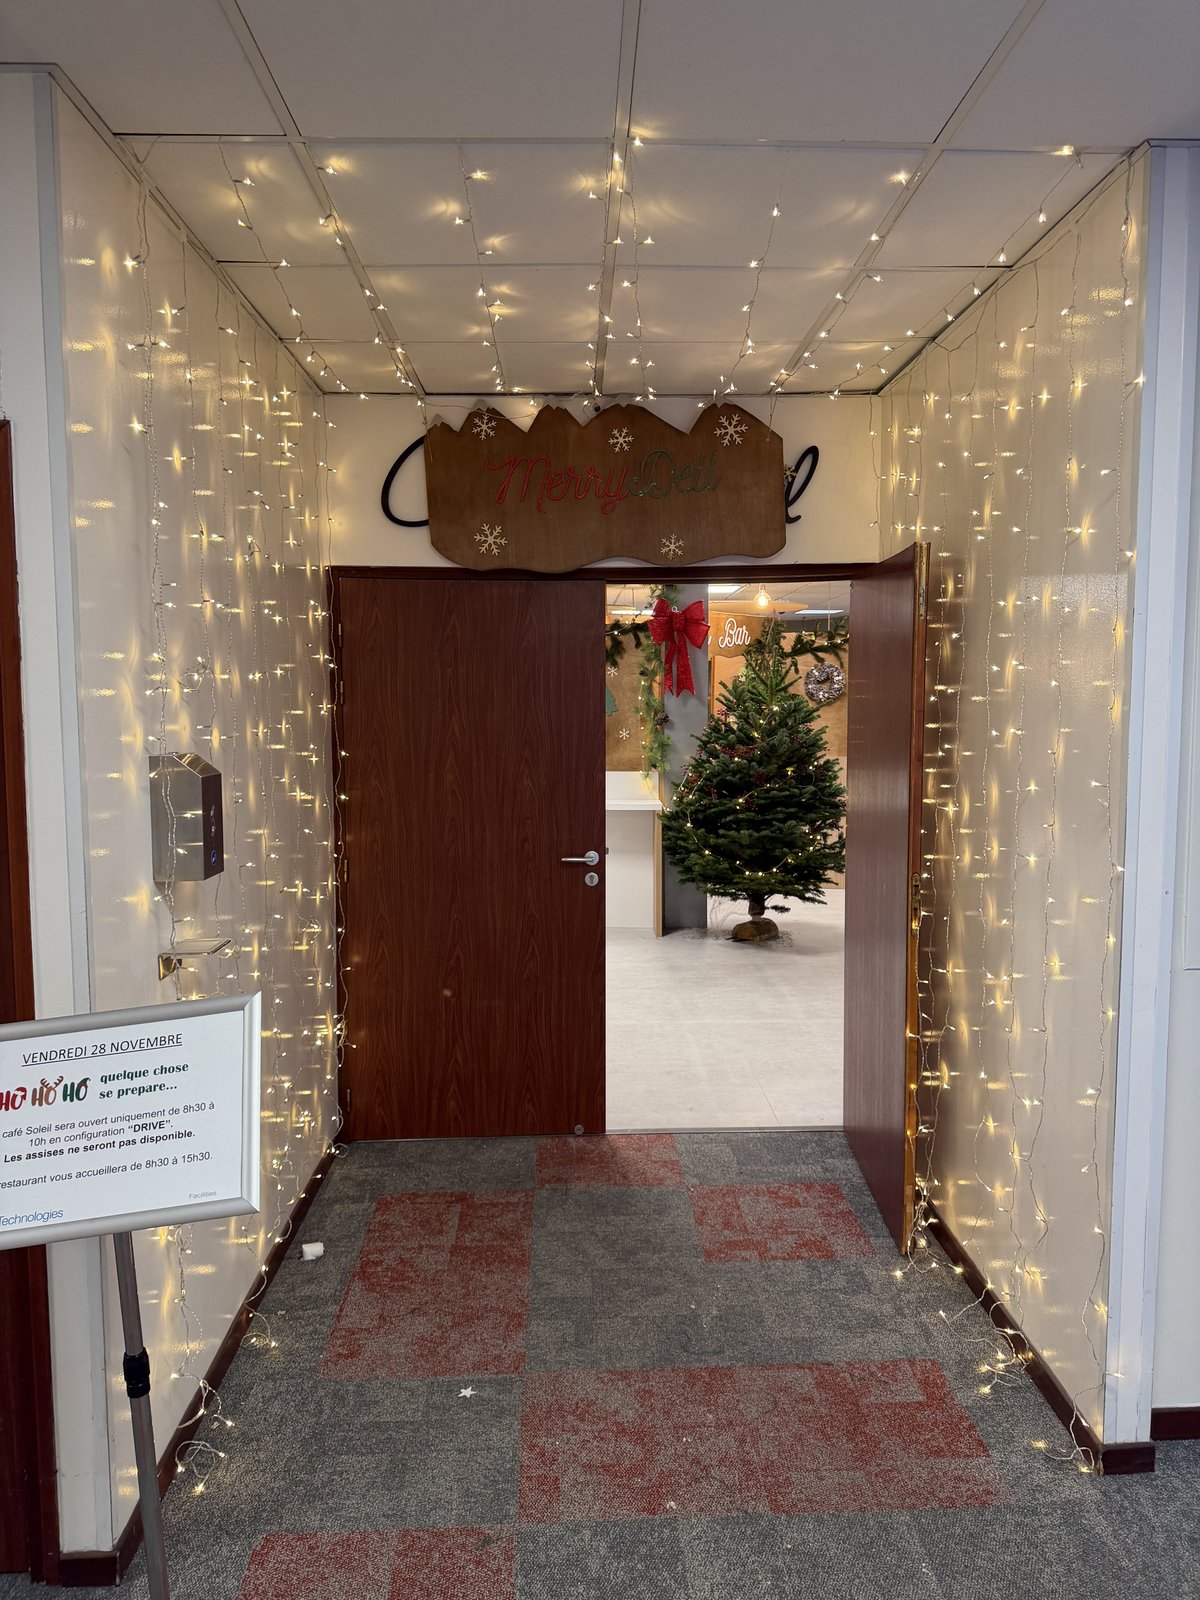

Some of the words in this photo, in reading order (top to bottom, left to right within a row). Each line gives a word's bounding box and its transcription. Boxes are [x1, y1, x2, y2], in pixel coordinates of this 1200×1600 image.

[484, 455, 632, 516] Merry
[718, 618, 751, 649] Bar
[22, 1045, 88, 1065] VENDREDI
[90, 1044, 107, 1056] 28
[110, 1033, 183, 1054] NOVEMBRE
[100, 1068, 149, 1085] quelque
[153, 1063, 189, 1076] chose
[0, 1086, 27, 1112] HO
[31, 1080, 60, 1107] HO
[62, 1077, 91, 1103] HO
[99, 1090, 114, 1100] se
[117, 1082, 178, 1099] prepare...
[2, 1127, 23, 1139] café
[25, 1123, 52, 1136] Soleil
[54, 1121, 76, 1132] sera
[78, 1116, 108, 1129] ouvert
[110, 1108, 166, 1124] uniquement
[168, 1106, 180, 1116] de
[182, 1102, 207, 1114] 8h30
[208, 1101, 215, 1110] à
[4, 1153, 23, 1163] Les
[25, 1148, 65, 1161] assises
[67, 1146, 80, 1155] ne
[83, 1141, 116, 1153] seront
[118, 1138, 137, 1149] pas
[139, 1129, 196, 1145] disponible.
[29, 1137, 47, 1147] 10h
[49, 1136, 61, 1145] en
[63, 1126, 125, 1143] configuration
[0, 1175, 47, 1189] estaurant
[49, 1172, 73, 1182] vous
[75, 1164, 127, 1178] accueillera
[130, 1162, 143, 1171] de
[145, 1157, 170, 1169] 8h30
[171, 1156, 178, 1165] à
[181, 1151, 213, 1164] 15h30.
[188, 1190, 217, 1201] Facilities
